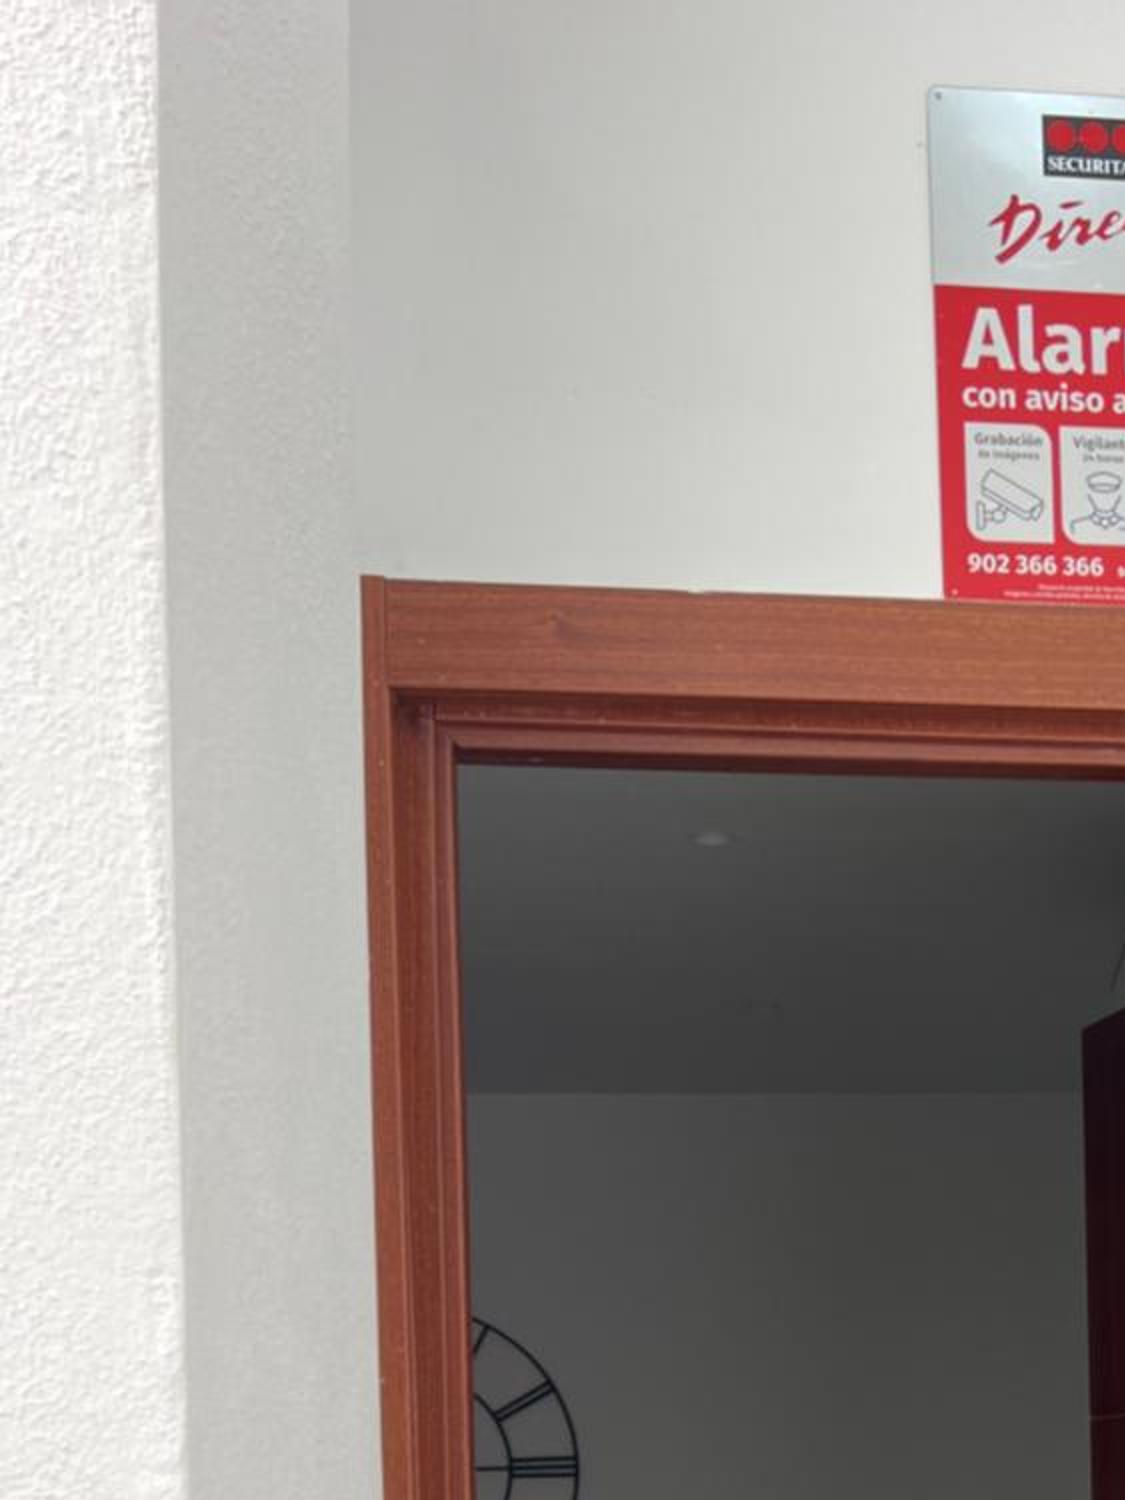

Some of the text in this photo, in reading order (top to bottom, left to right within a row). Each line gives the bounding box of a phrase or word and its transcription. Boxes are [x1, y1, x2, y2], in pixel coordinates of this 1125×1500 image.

[962, 385, 1017, 409] con
[1025, 382, 1104, 413] aviso
[967, 553, 1010, 574] 902
[1016, 555, 1057, 576] 366
[1062, 557, 1105, 577] 366
